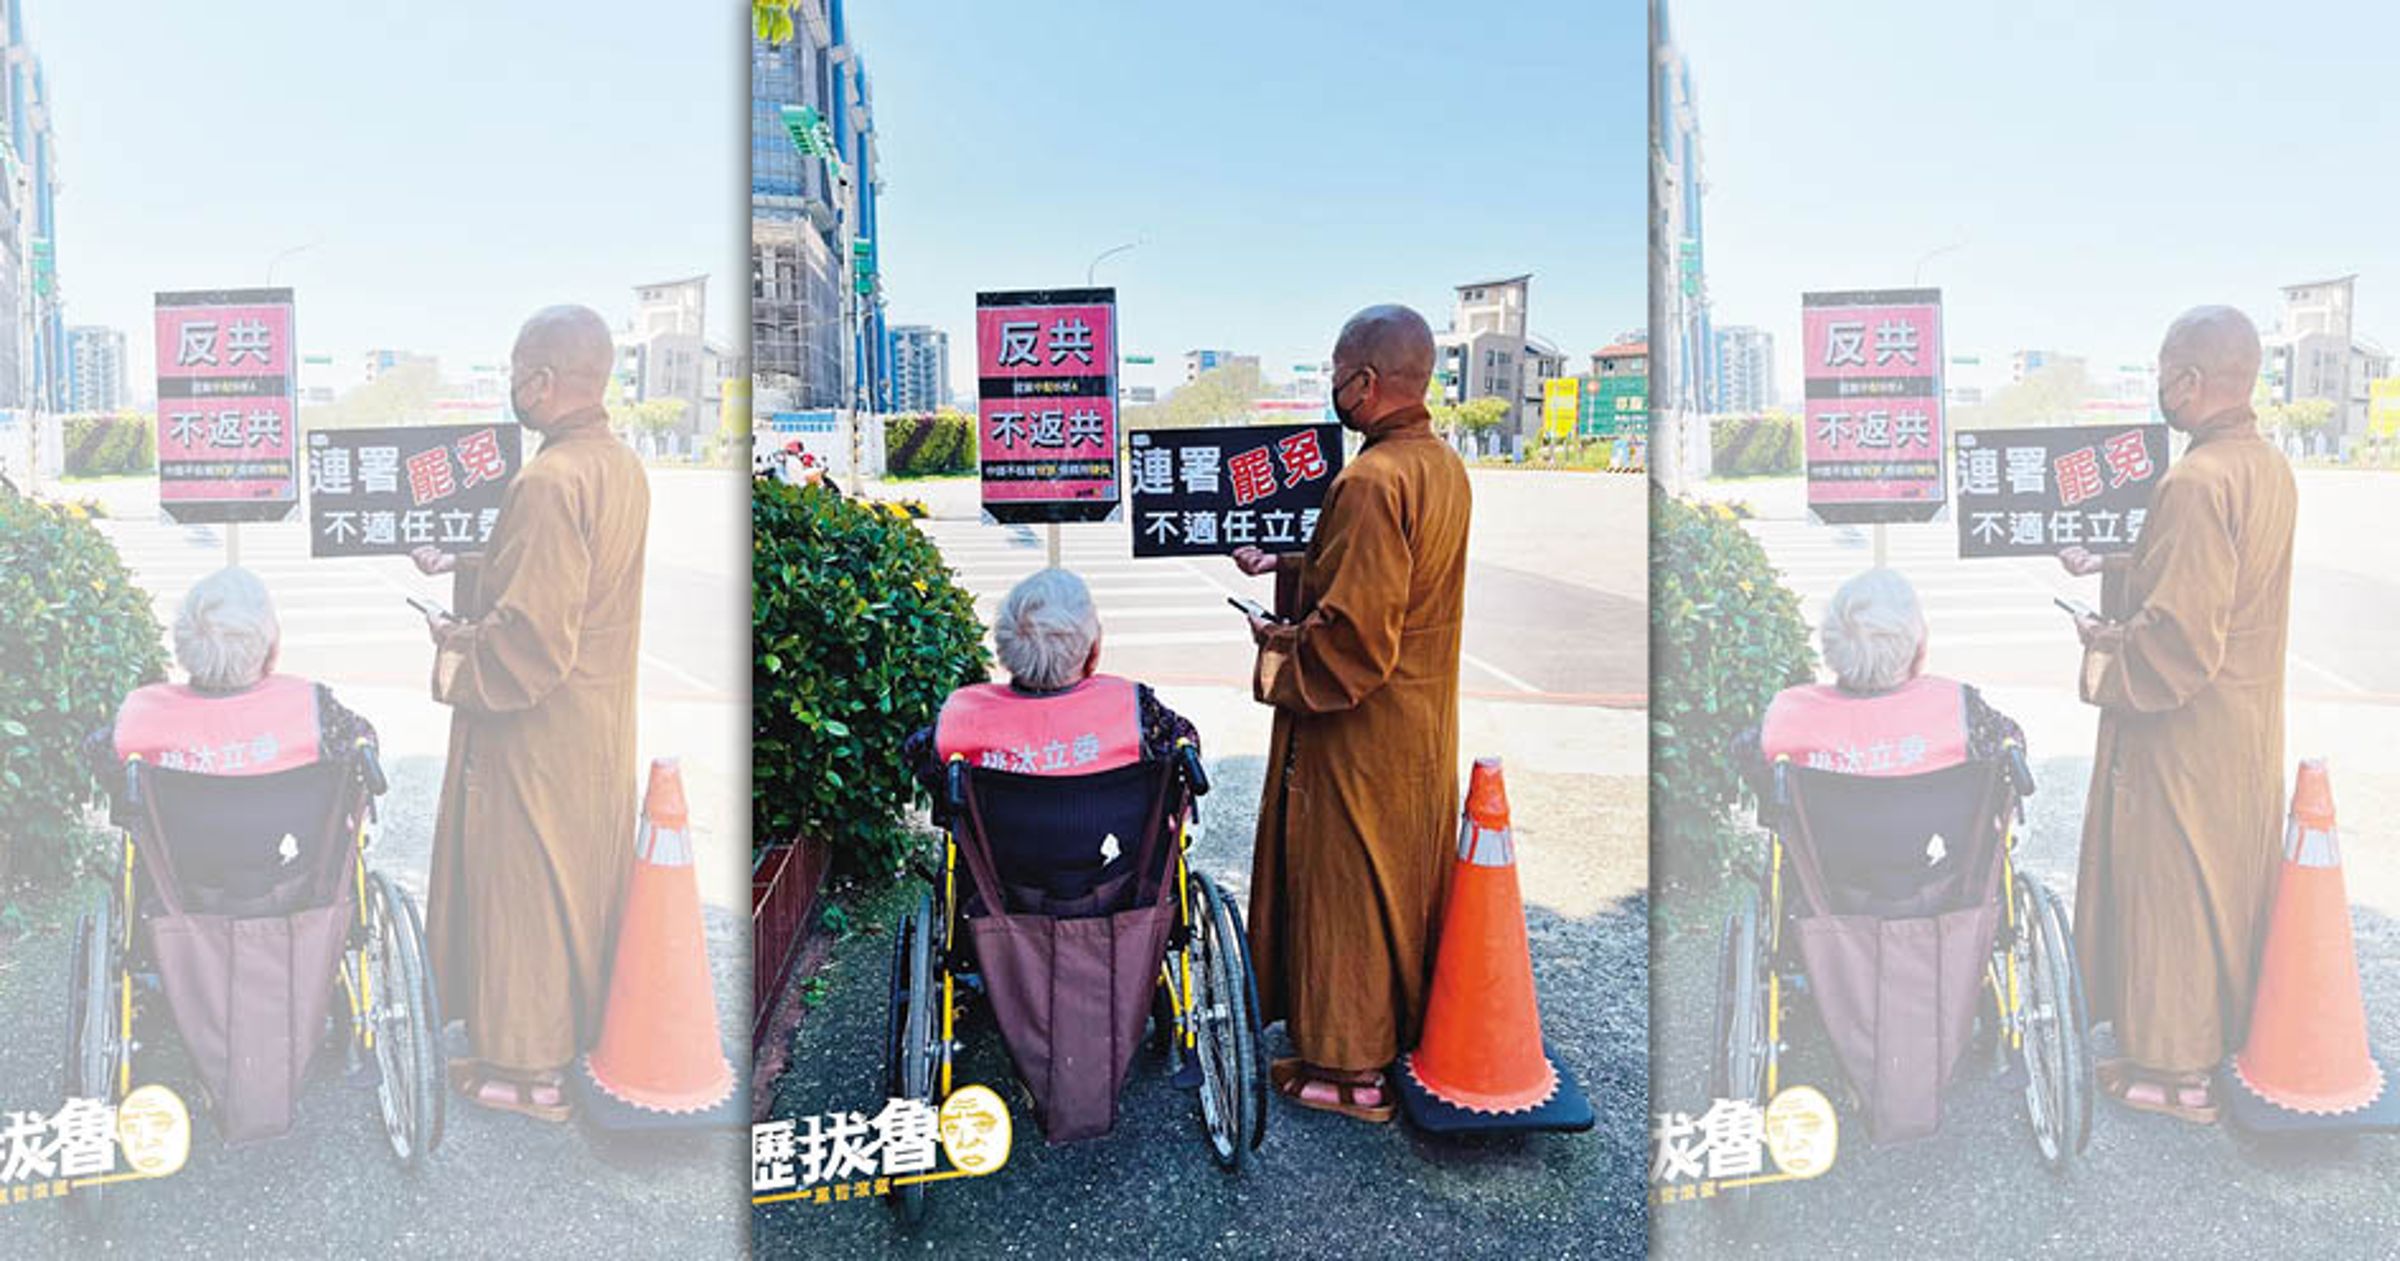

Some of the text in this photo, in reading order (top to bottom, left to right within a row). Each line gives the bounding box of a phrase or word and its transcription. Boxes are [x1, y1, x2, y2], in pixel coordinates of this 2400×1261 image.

[175, 317, 272, 366] 反共
[997, 317, 1094, 366] 反共
[1823, 317, 1920, 366] 反共
[168, 410, 283, 450] 不返共
[990, 410, 1105, 450] 不返共
[1816, 410, 1931, 450] 不返共
